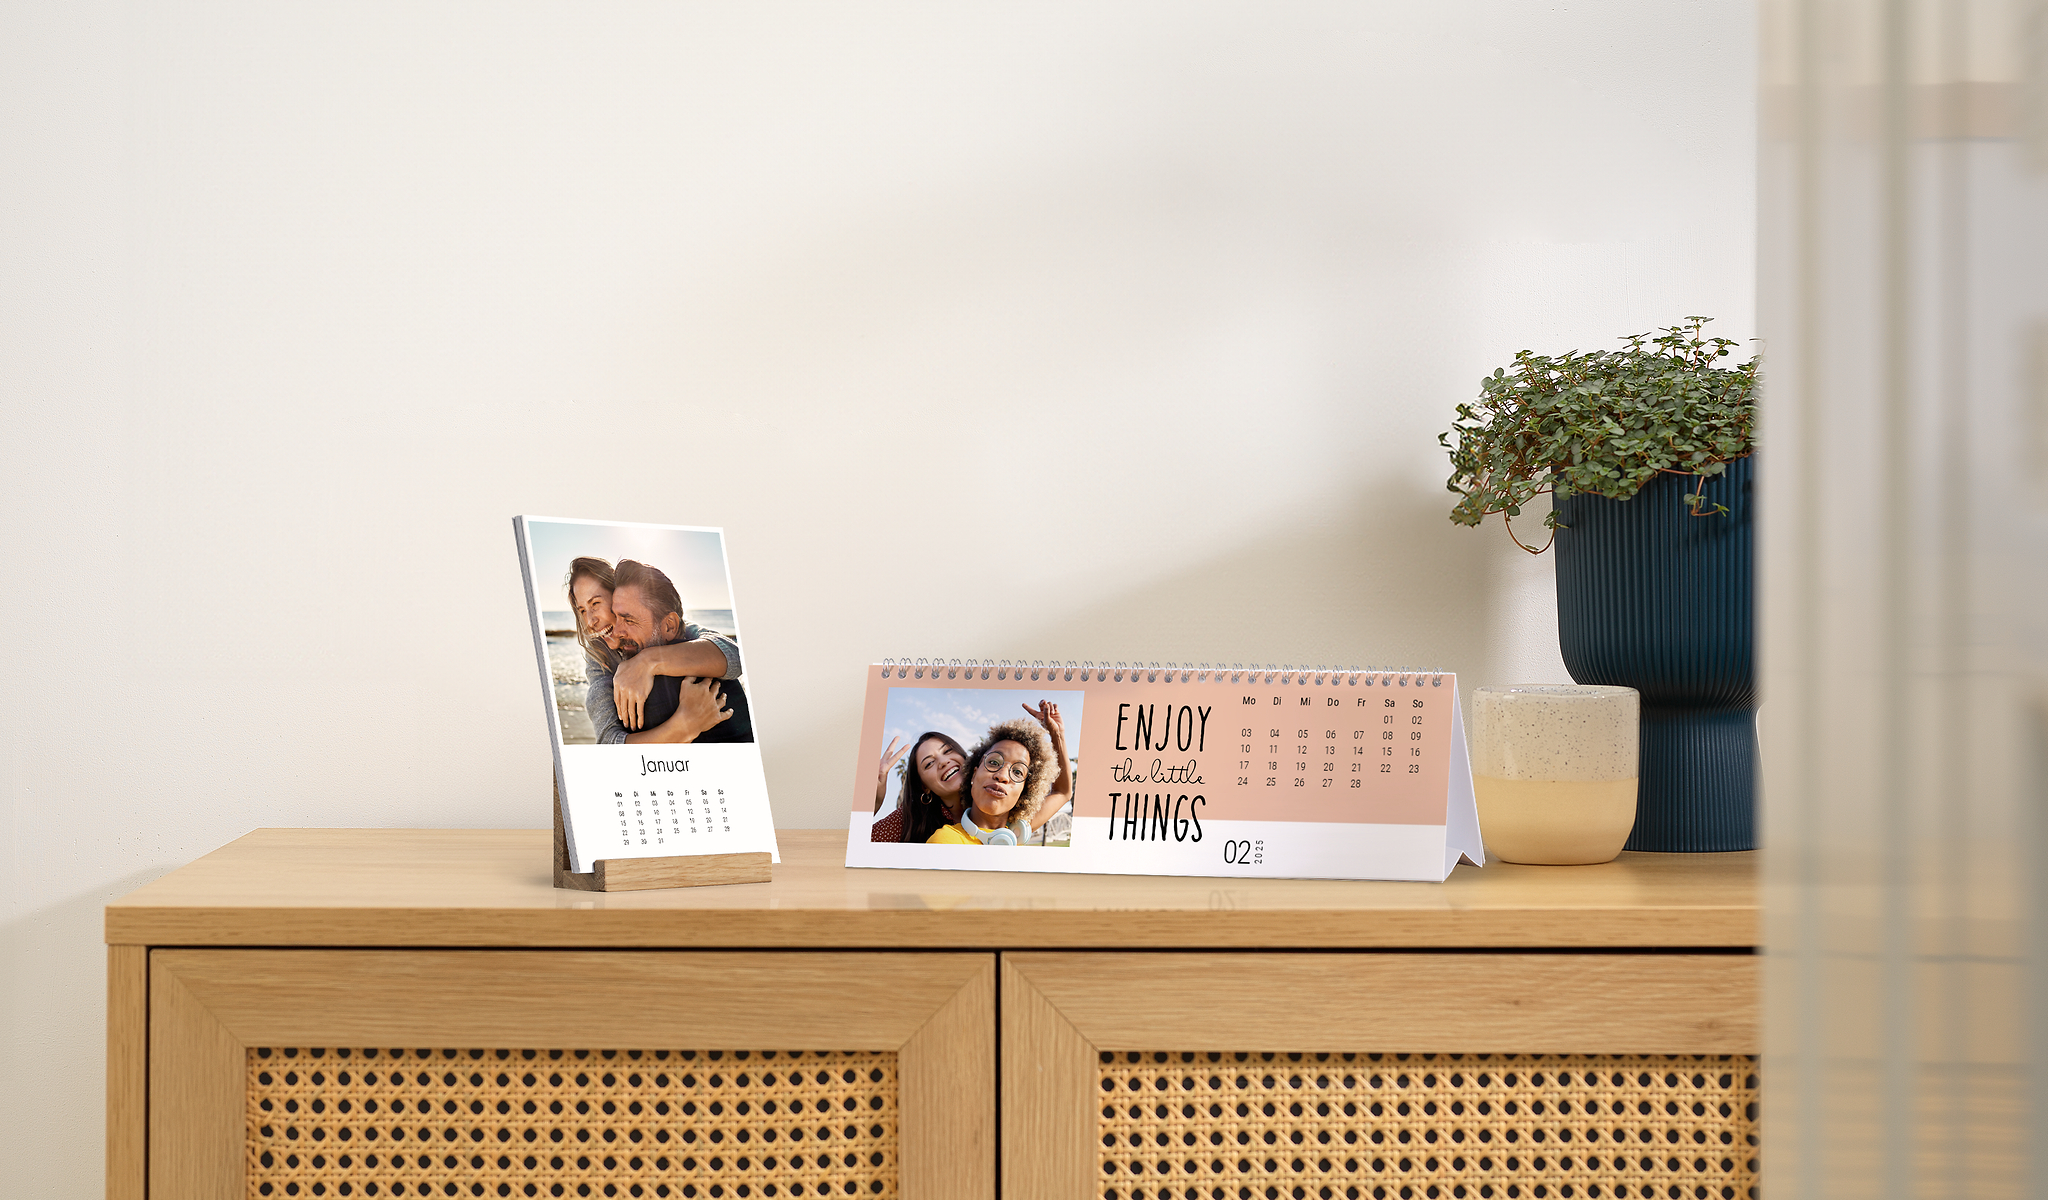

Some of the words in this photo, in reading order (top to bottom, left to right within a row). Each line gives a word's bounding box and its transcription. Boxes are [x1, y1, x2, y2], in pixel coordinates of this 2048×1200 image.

[1242, 696, 1256, 706] Mo
[1272, 696, 1282, 706] Di
[1300, 696, 1310, 706] Mi
[1328, 698, 1340, 706] Do
[1358, 698, 1366, 706] Fr
[1384, 698, 1396, 708] Sa
[1412, 698, 1424, 708] So
[1116, 703, 1211, 752] ENJOY
[1384, 714, 1394, 724] 01
[1412, 716, 1422, 724] 02
[1242, 728, 1252, 738] 03
[1270, 728, 1280, 738] 04
[1298, 730, 1308, 738] 05
[1326, 730, 1336, 740] 06
[1354, 730, 1364, 740] 07
[1382, 730, 1394, 740] 08
[1410, 732, 1422, 740] 09
[1240, 744, 1250, 754] 10
[1270, 744, 1278, 754] 11
[1298, 746, 1308, 754] 12
[1326, 746, 1336, 754] 13
[1354, 746, 1364, 756] 14
[1382, 746, 1392, 756] 15
[1410, 748, 1420, 756] 16
[641, 755, 690, 776] Januar
[1111, 758, 1147, 783] the
[1151, 758, 1205, 784] little
[1240, 760, 1250, 770] 17
[1268, 762, 1278, 770] 18
[1296, 762, 1306, 772] 19
[1324, 762, 1334, 772] 20
[1352, 762, 1360, 772] 21
[1380, 764, 1392, 772] 22
[1408, 764, 1420, 774] 23
[1238, 776, 1248, 786] 24
[1266, 776, 1276, 786] 25
[1294, 778, 1304, 788] 26
[1322, 778, 1332, 788] 27
[1350, 778, 1362, 788] 28
[1109, 792, 1206, 842] THINGS
[1224, 840, 1250, 864] 02
[1254, 840, 1263, 864] 2025
